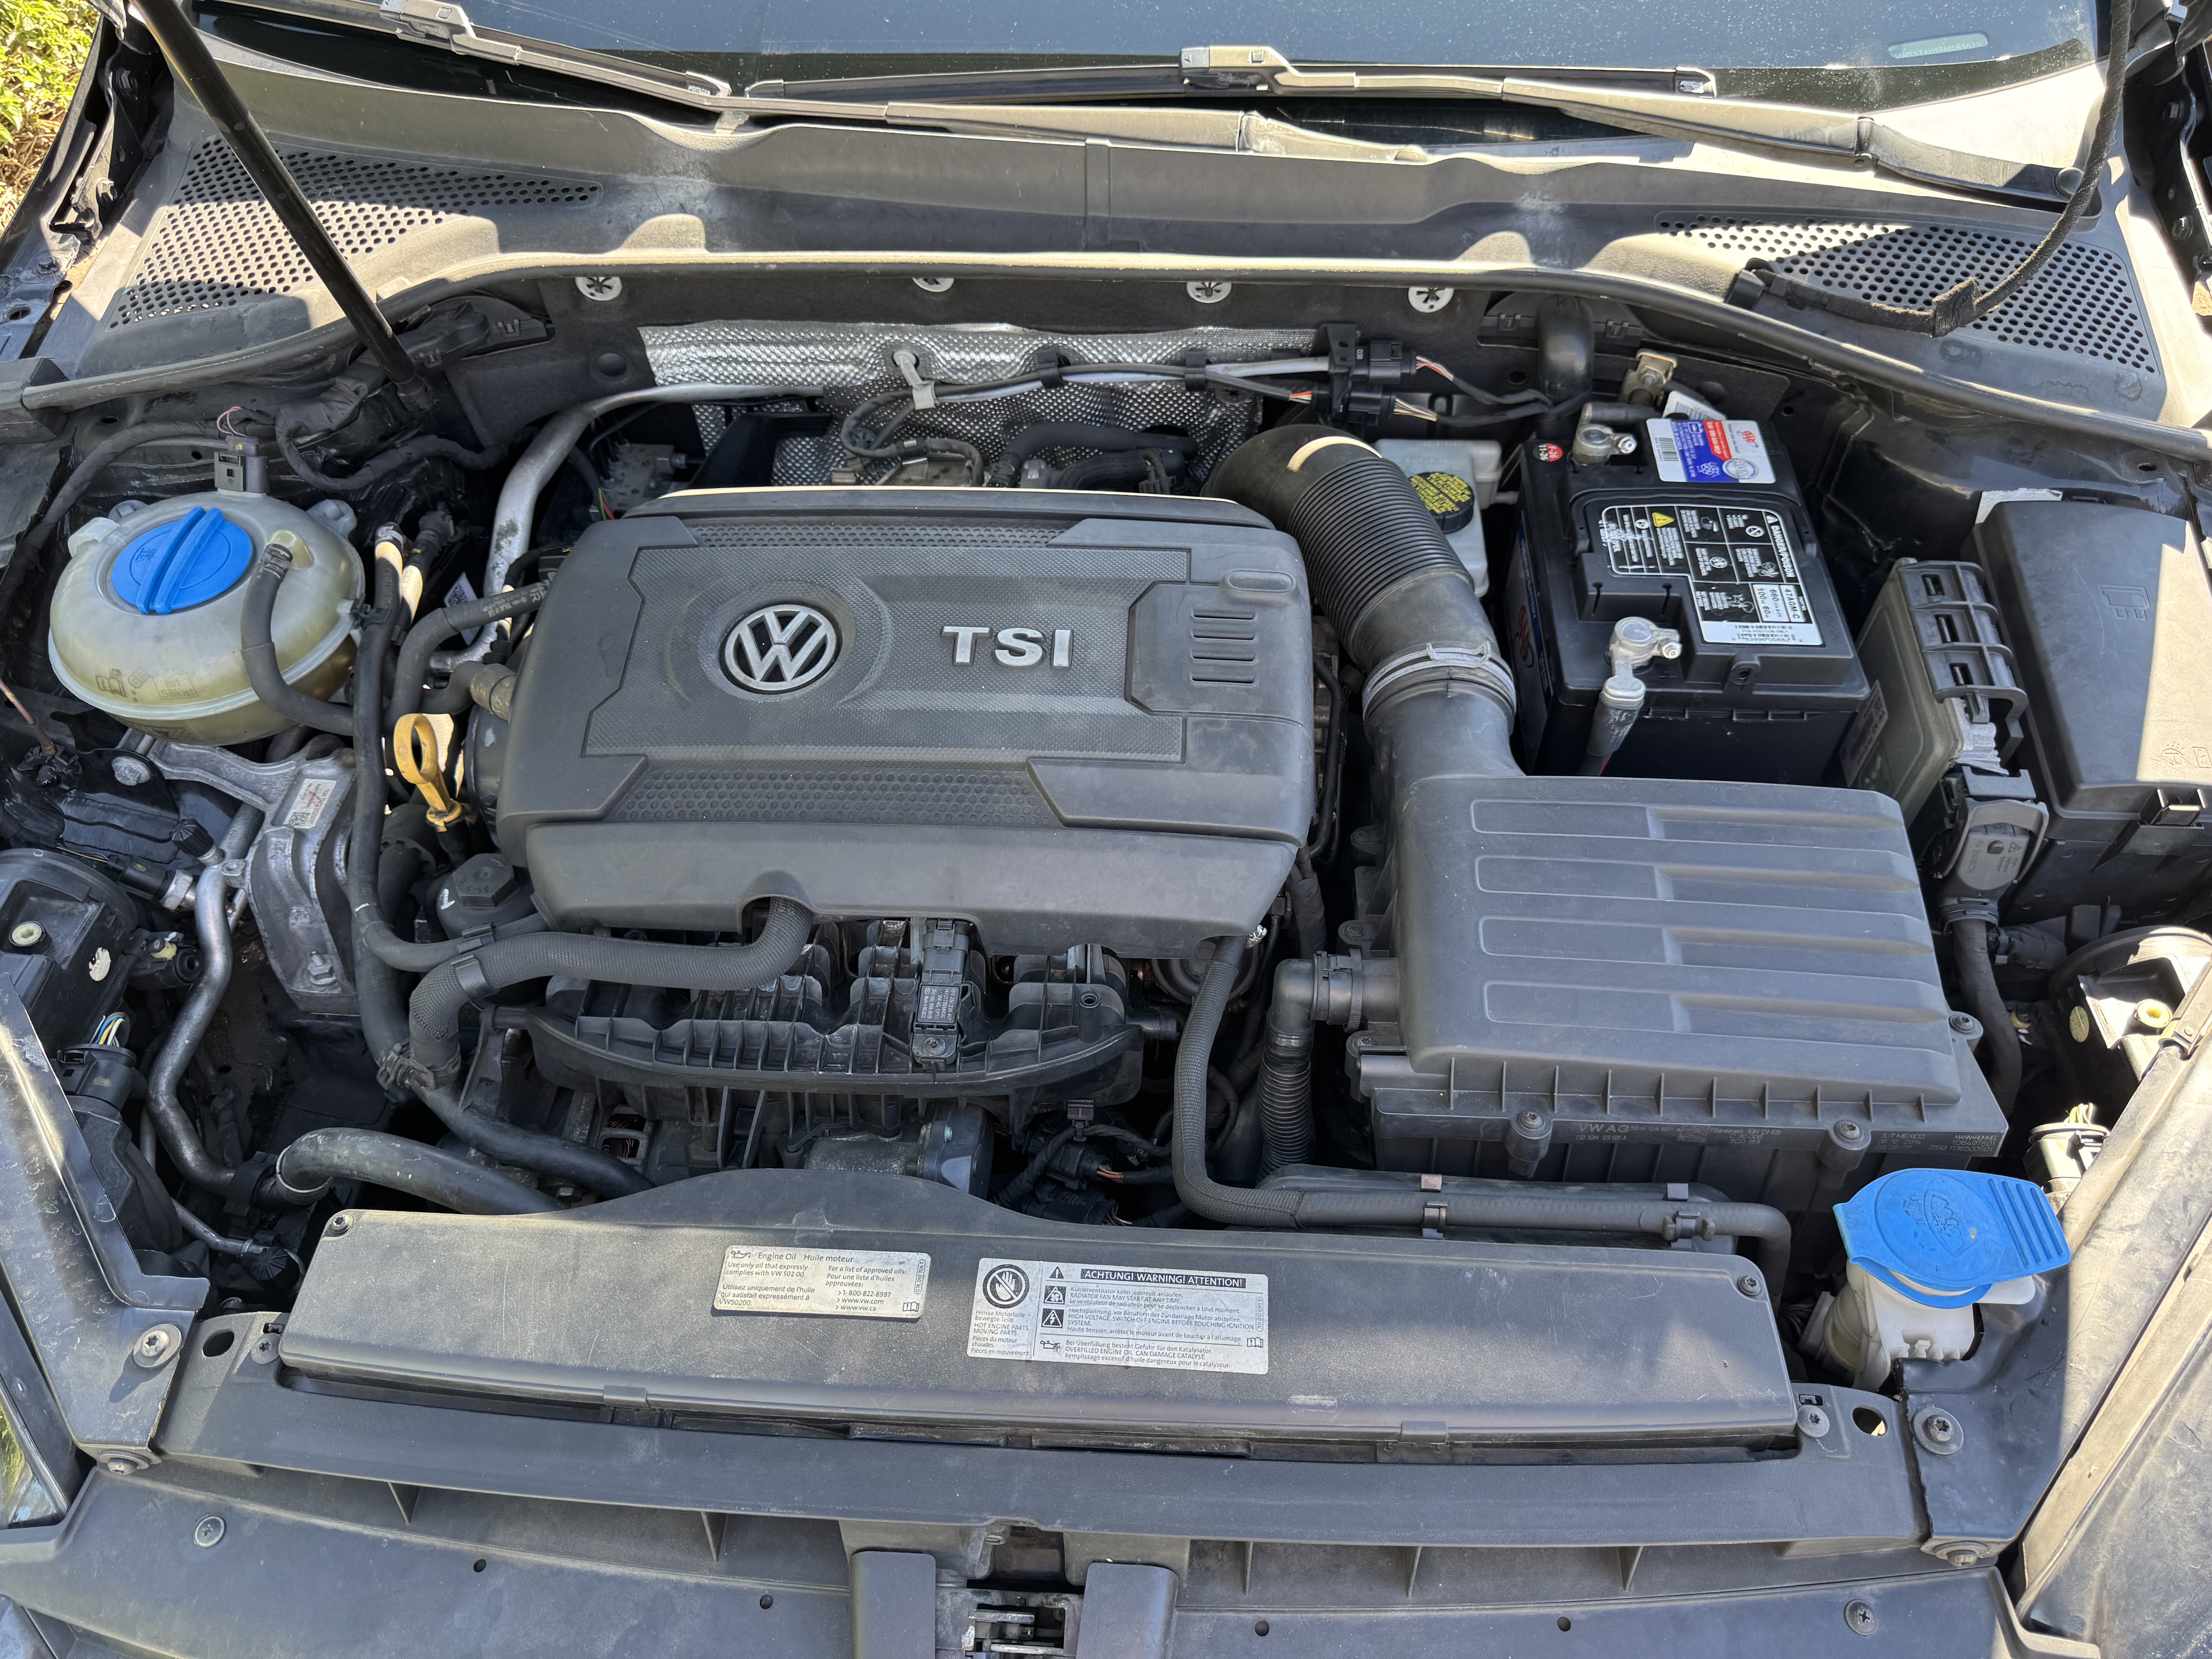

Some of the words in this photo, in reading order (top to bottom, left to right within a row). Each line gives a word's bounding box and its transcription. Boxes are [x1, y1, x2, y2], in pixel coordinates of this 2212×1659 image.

[1733, 460, 1748, 478] AGM
[1770, 525, 1795, 577] DANGER/POISON
[1757, 588, 1767, 599] 100
[1769, 589, 1779, 601] 660
[1784, 589, 1800, 618] 47AGM-C
[942, 626, 1073, 668] TSI
[166, 677, 181, 687] mit
[161, 689, 195, 698] Silikat
[1578, 1124, 1604, 1132] VW
[1605, 1124, 1629, 1133] AG
[757, 1252, 784, 1260] Engine
[1084, 1270, 1133, 1280] ACHTUNG!
[1136, 1273, 1185, 1283] WARNING!
[1187, 1276, 1242, 1287] ATTENTION!
[1076, 1340, 1110, 1349] Überfüllung
[1112, 1342, 1133, 1350] besteht
[1134, 1343, 1155, 1352] Gefahr
[1157, 1345, 1165, 1353] für
[1166, 1345, 1177, 1353] den
[1178, 1346, 1212, 1355] Katalysator.
